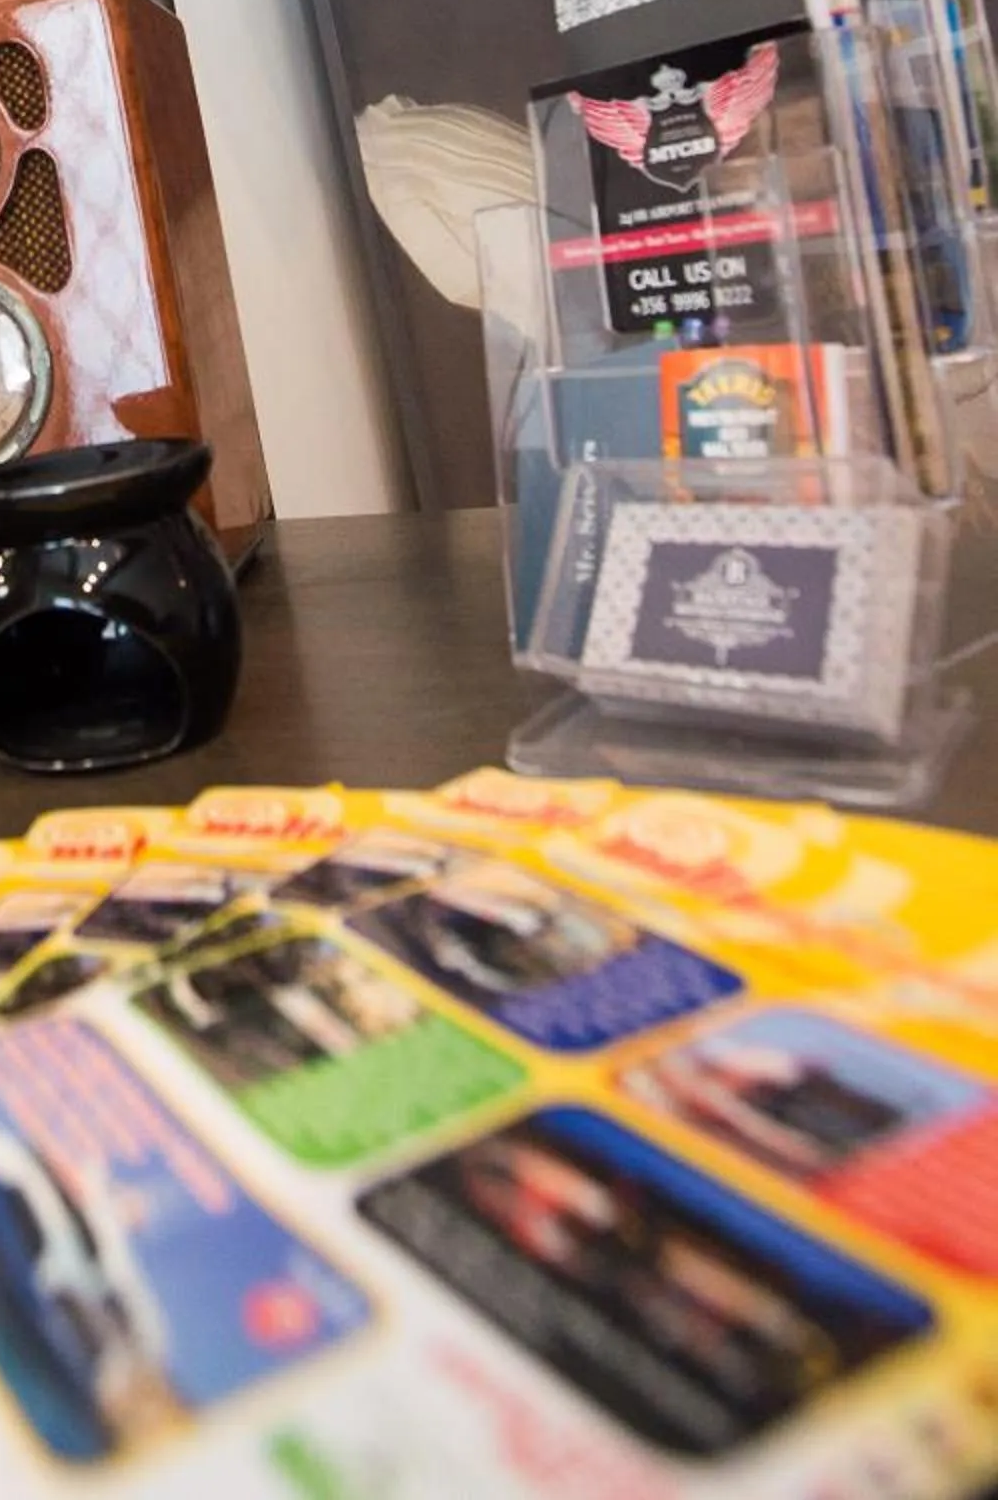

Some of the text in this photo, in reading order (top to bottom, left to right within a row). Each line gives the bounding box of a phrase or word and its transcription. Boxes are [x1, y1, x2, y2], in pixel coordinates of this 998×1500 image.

[628, 256, 747, 290] CALL US ON
